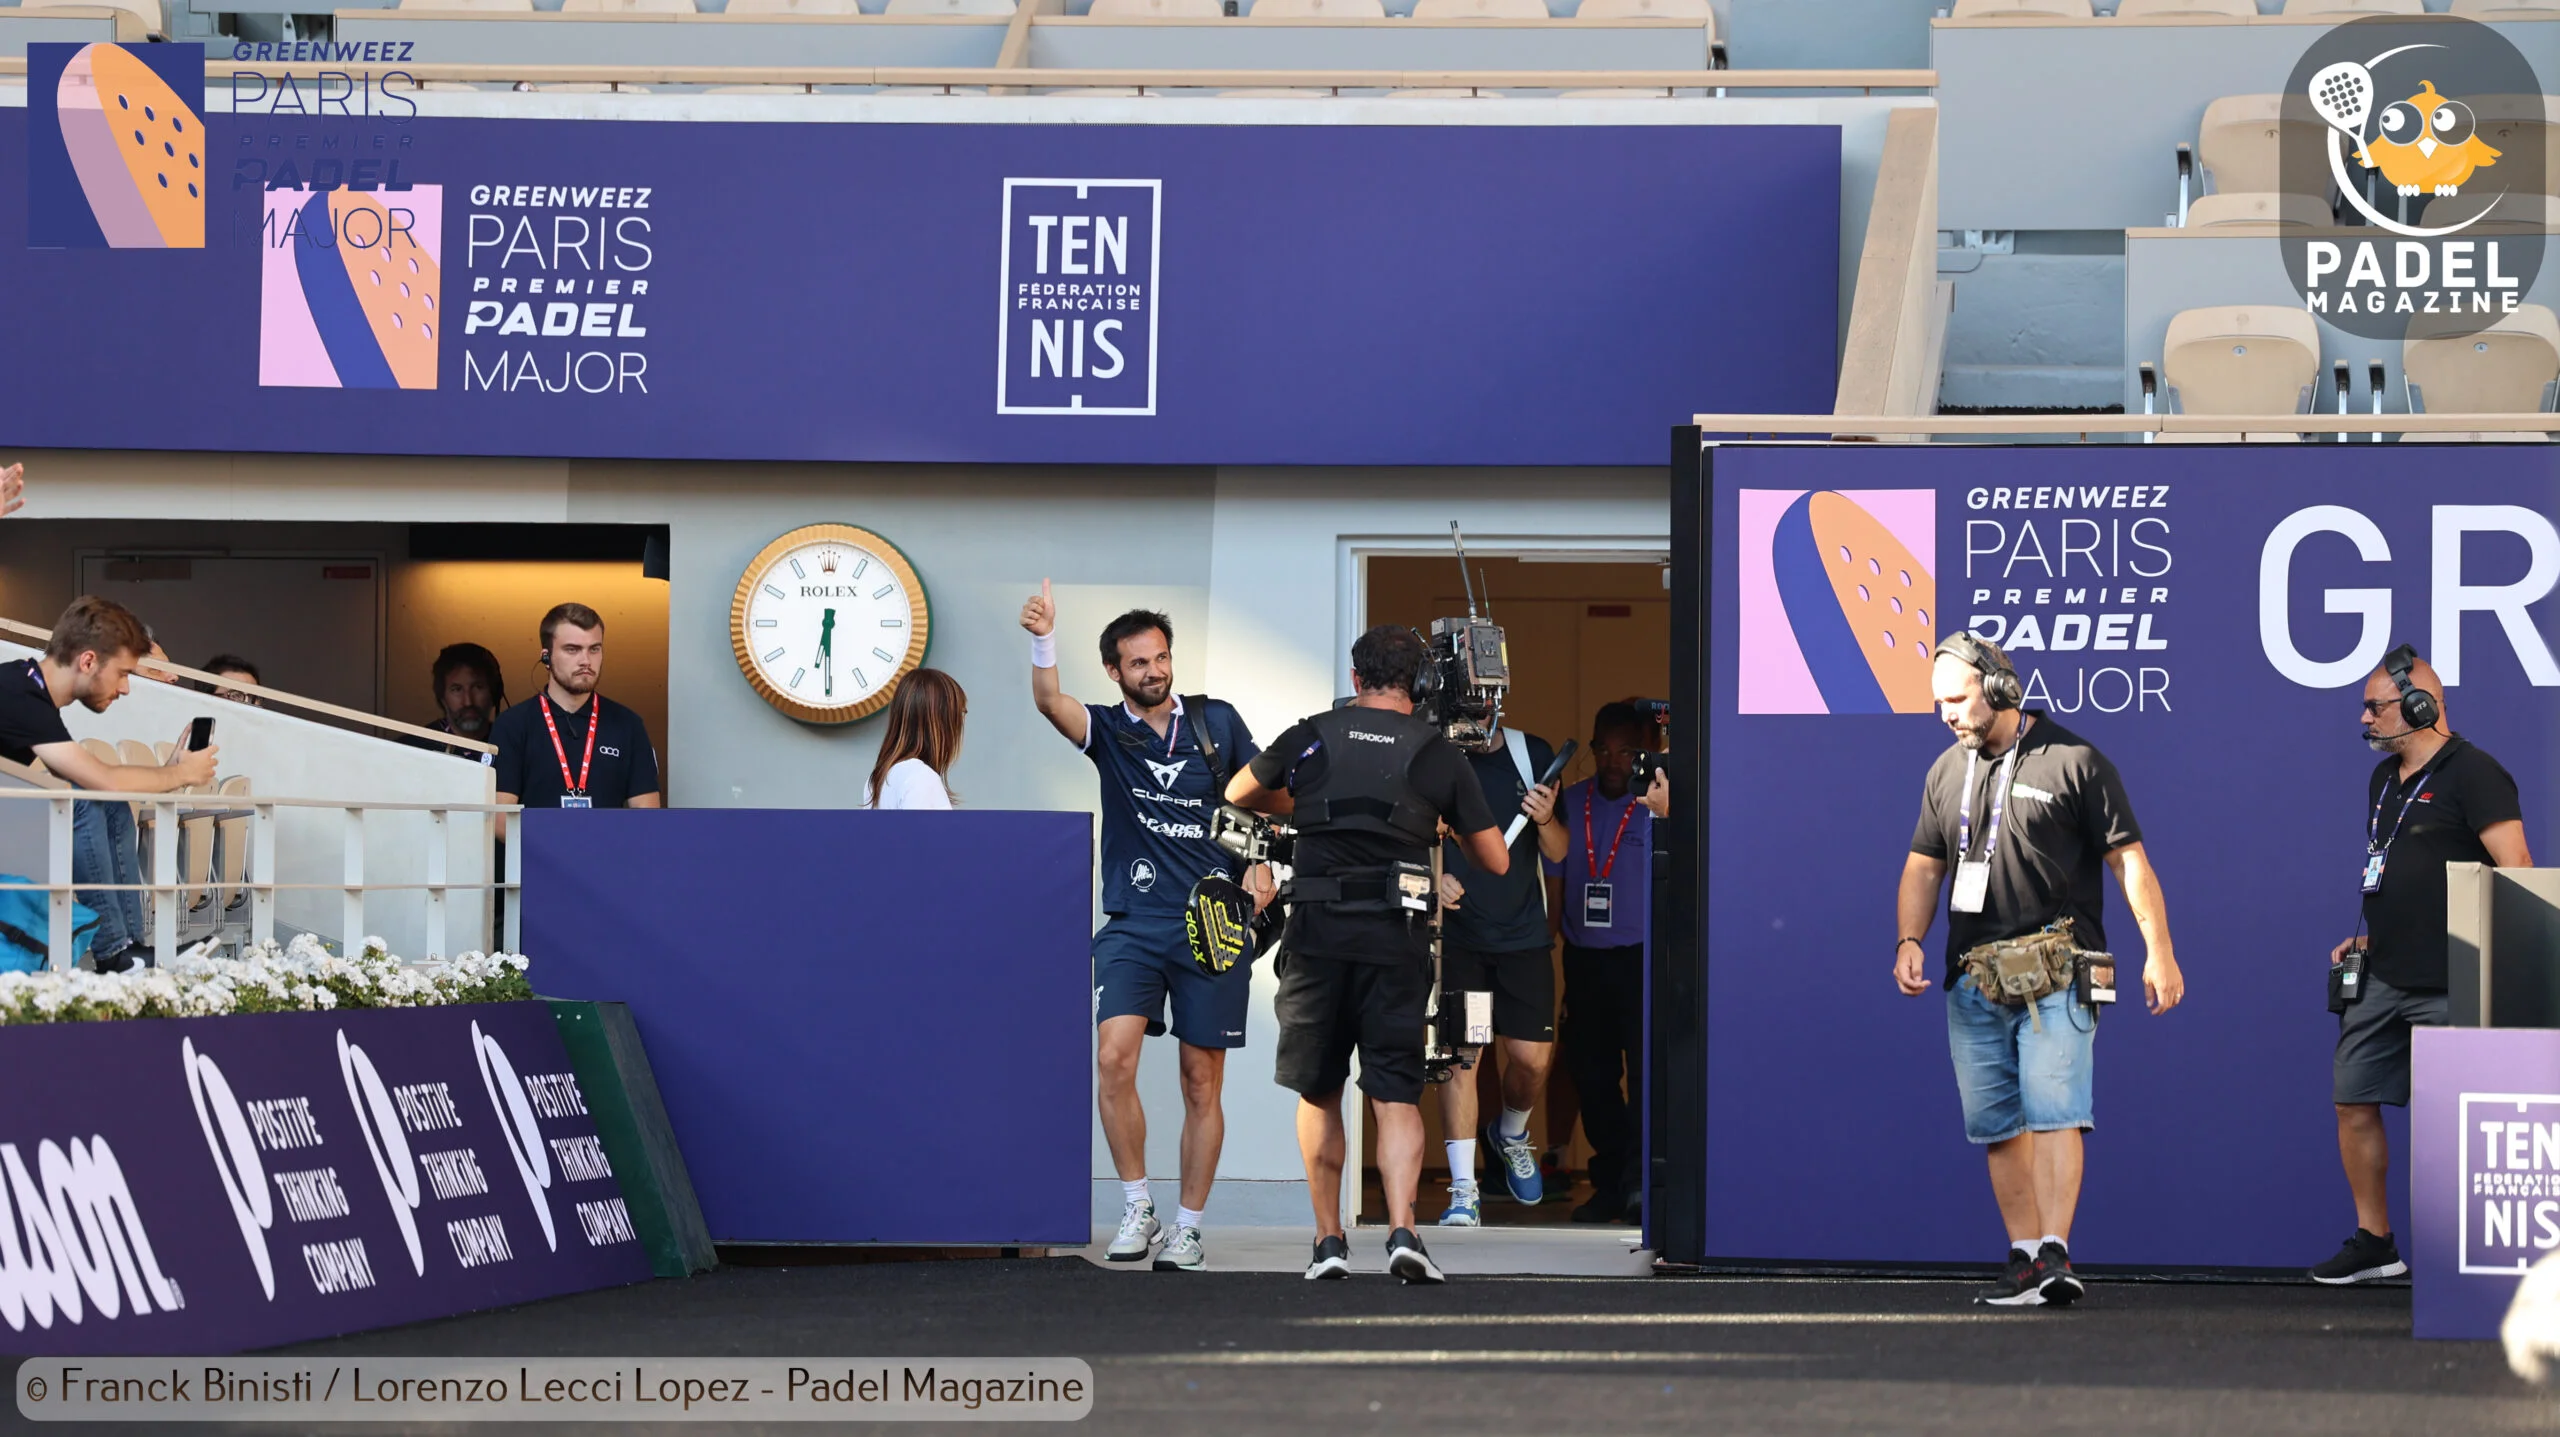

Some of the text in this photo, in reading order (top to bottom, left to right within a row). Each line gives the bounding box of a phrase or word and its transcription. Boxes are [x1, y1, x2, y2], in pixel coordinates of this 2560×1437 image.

[470, 185, 652, 209] GREENWEEZ
[468, 214, 652, 272] PARIS
[1029, 215, 1128, 275] TEN
[473, 277, 649, 295] PREMIER
[1018, 283, 1141, 296] FÉDÉRATION
[1018, 297, 1141, 311] FRANÇAISE
[464, 301, 647, 337] PADEL
[1030, 318, 1125, 379] NIS
[464, 349, 648, 394] MAJOR
[1967, 486, 2170, 509] GREENWEEZ
[1966, 518, 2172, 578] PARIS
[800, 586, 858, 597] ROLEX
[1973, 587, 2169, 605] PREMIER
[2259, 504, 2560, 689] GR
[1968, 614, 2168, 651] PADEL
[2019, 667, 2172, 713] AJOR
[1348, 730, 1395, 744] STEADICAM
[1132, 788, 1202, 807] CUPRA
[1185, 911, 1207, 963] X-TOP
[2480, 1121, 2560, 1170] TEN
[446, 1214, 514, 1269] COMPANY
[576, 1197, 637, 1247] COMPANY
[2485, 1200, 2560, 1249] NIS
[302, 1237, 376, 1295] COMPANY
